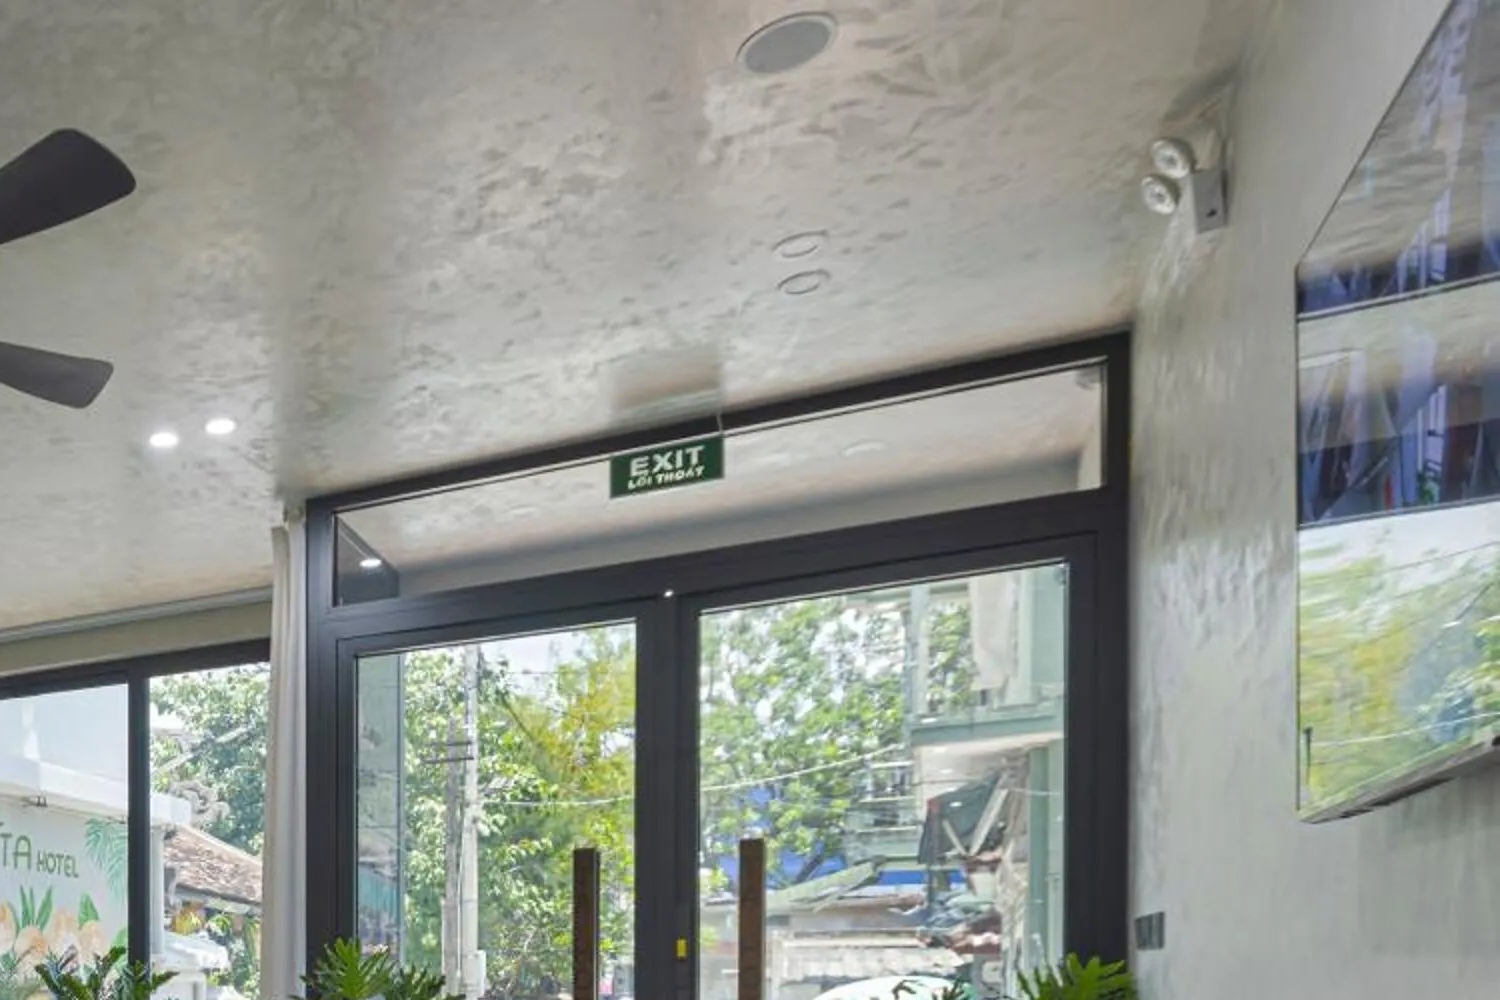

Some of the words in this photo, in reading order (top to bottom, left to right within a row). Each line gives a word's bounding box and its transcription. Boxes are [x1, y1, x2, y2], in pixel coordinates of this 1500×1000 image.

[630, 445, 705, 476] EXIT
[0, 833, 32, 870] TA
[37, 851, 79, 878] HOTEL
